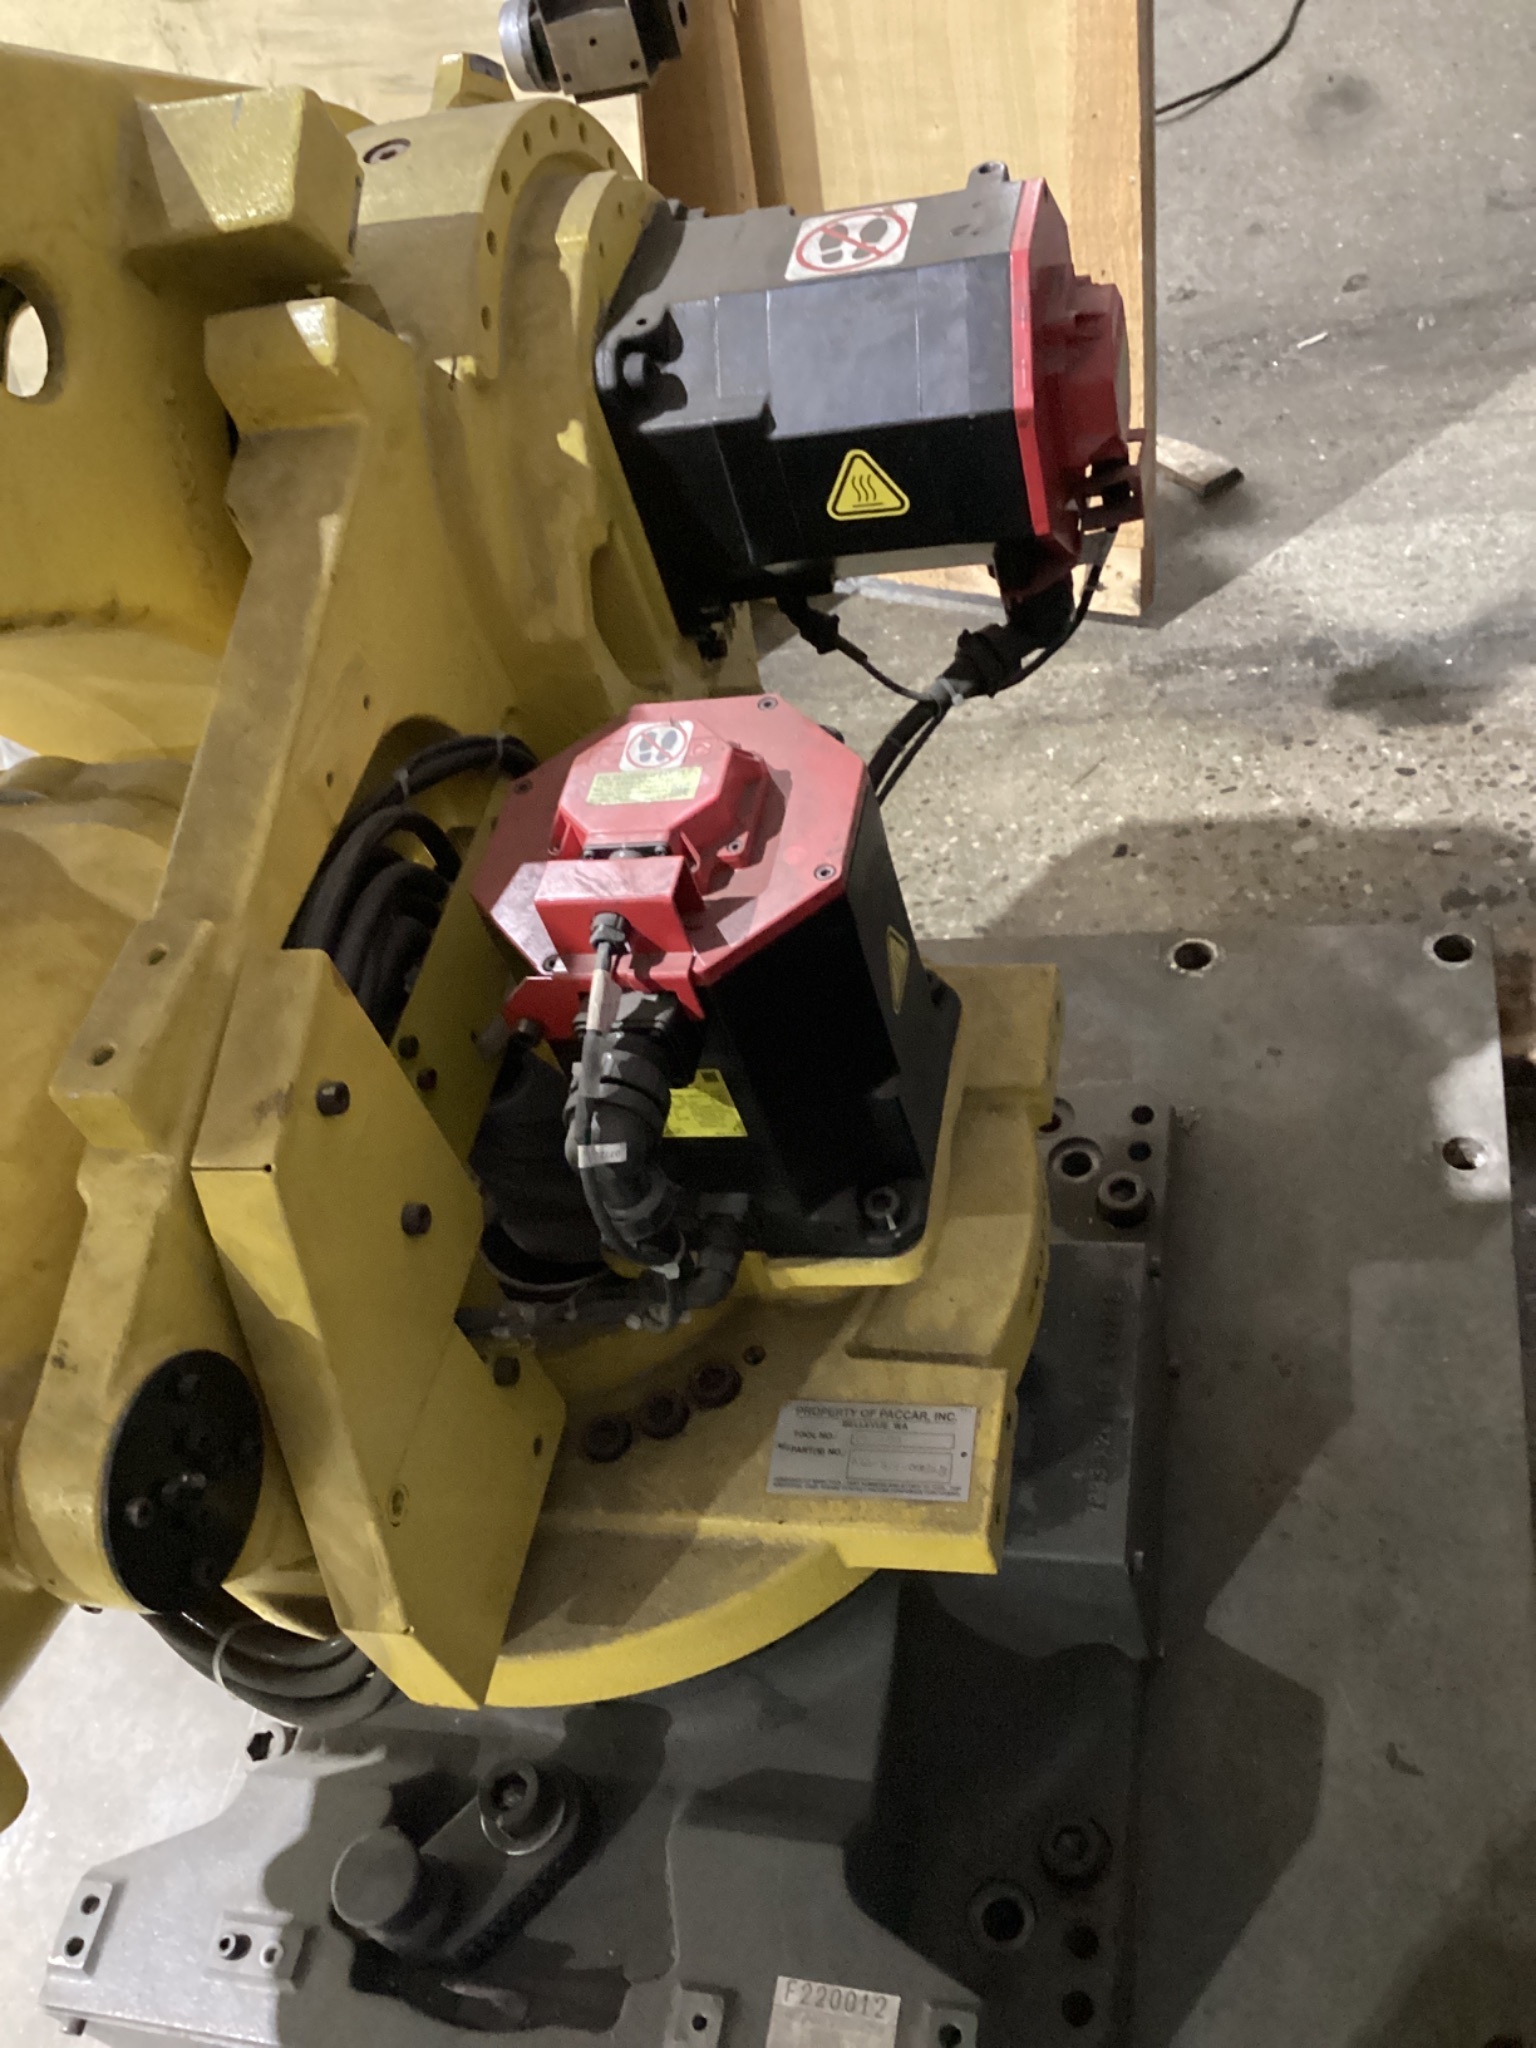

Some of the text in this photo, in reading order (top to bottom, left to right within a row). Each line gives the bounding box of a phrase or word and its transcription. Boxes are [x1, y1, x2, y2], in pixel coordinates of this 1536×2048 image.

[796, 1407, 857, 1418] PROPERTY
[860, 1408, 875, 1418] OF
[783, 1980, 887, 2018] F220012
